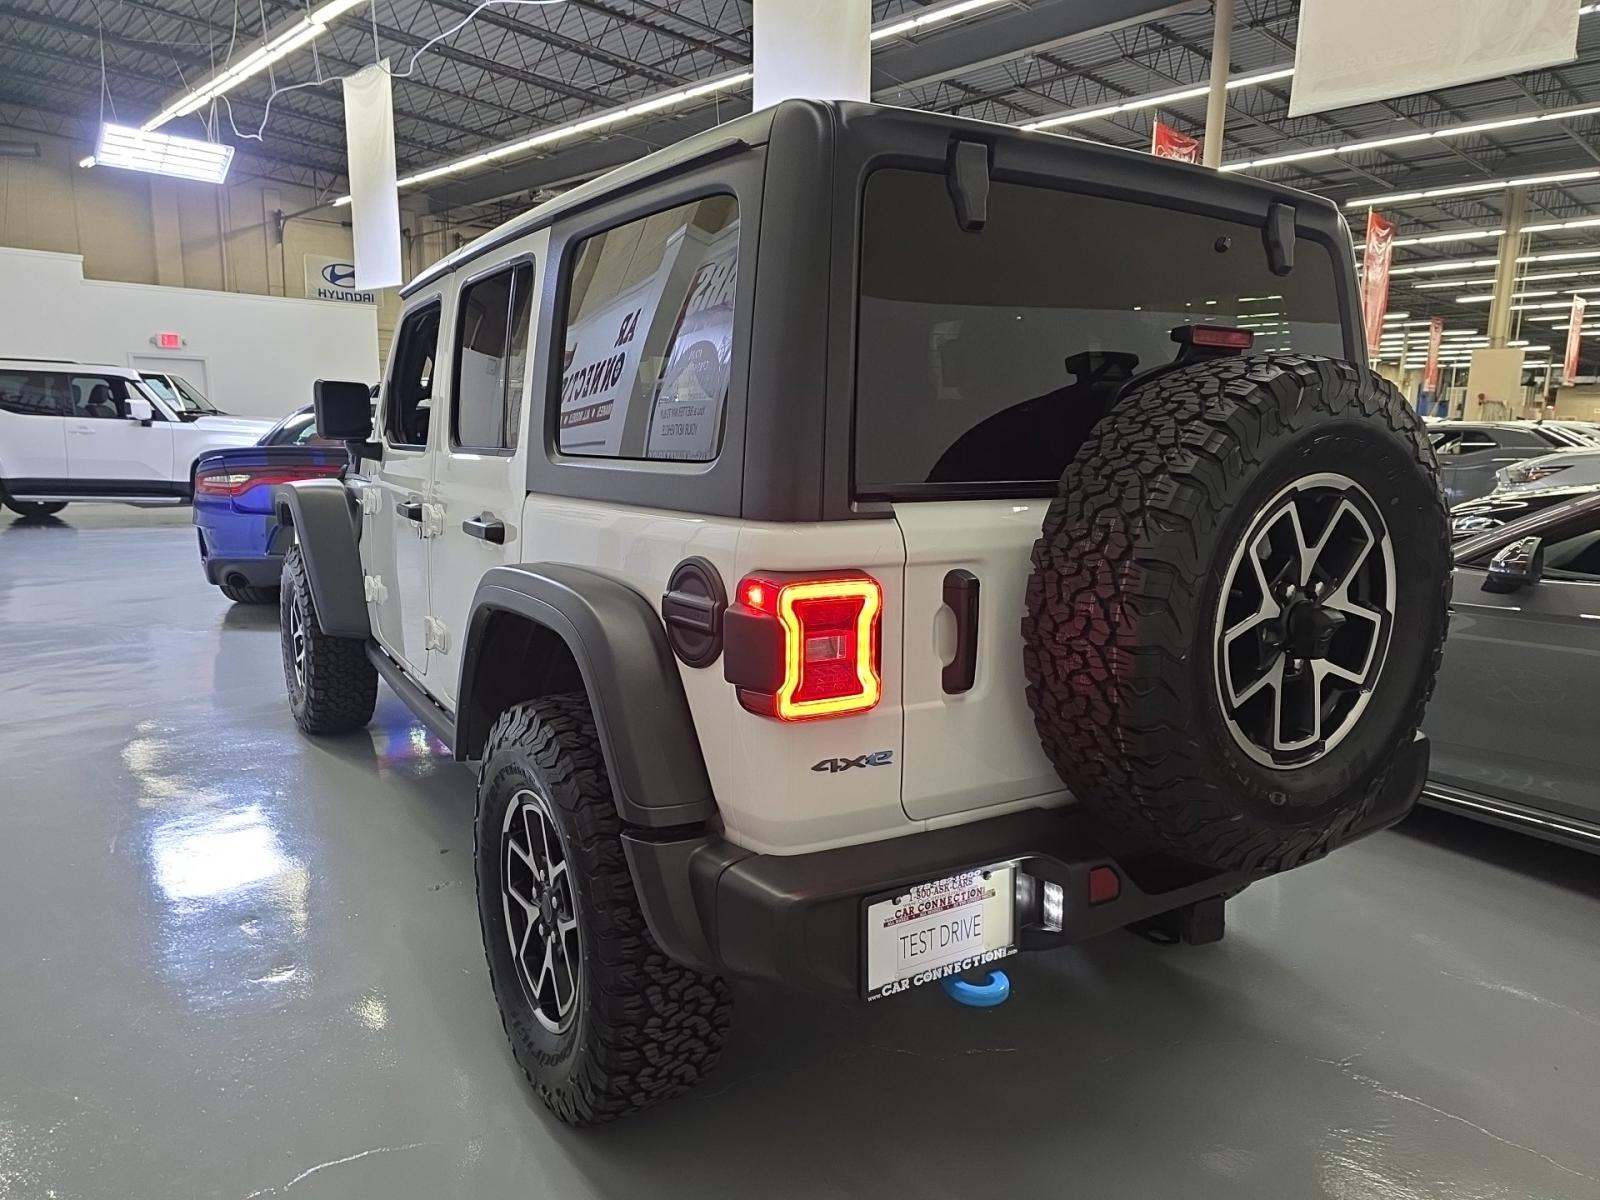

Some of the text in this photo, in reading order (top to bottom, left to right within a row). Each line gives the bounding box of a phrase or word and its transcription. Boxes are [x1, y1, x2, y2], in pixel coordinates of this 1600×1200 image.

[318, 288, 375, 303] HYUNDAI
[900, 914, 981, 959] TEST DRIVE
